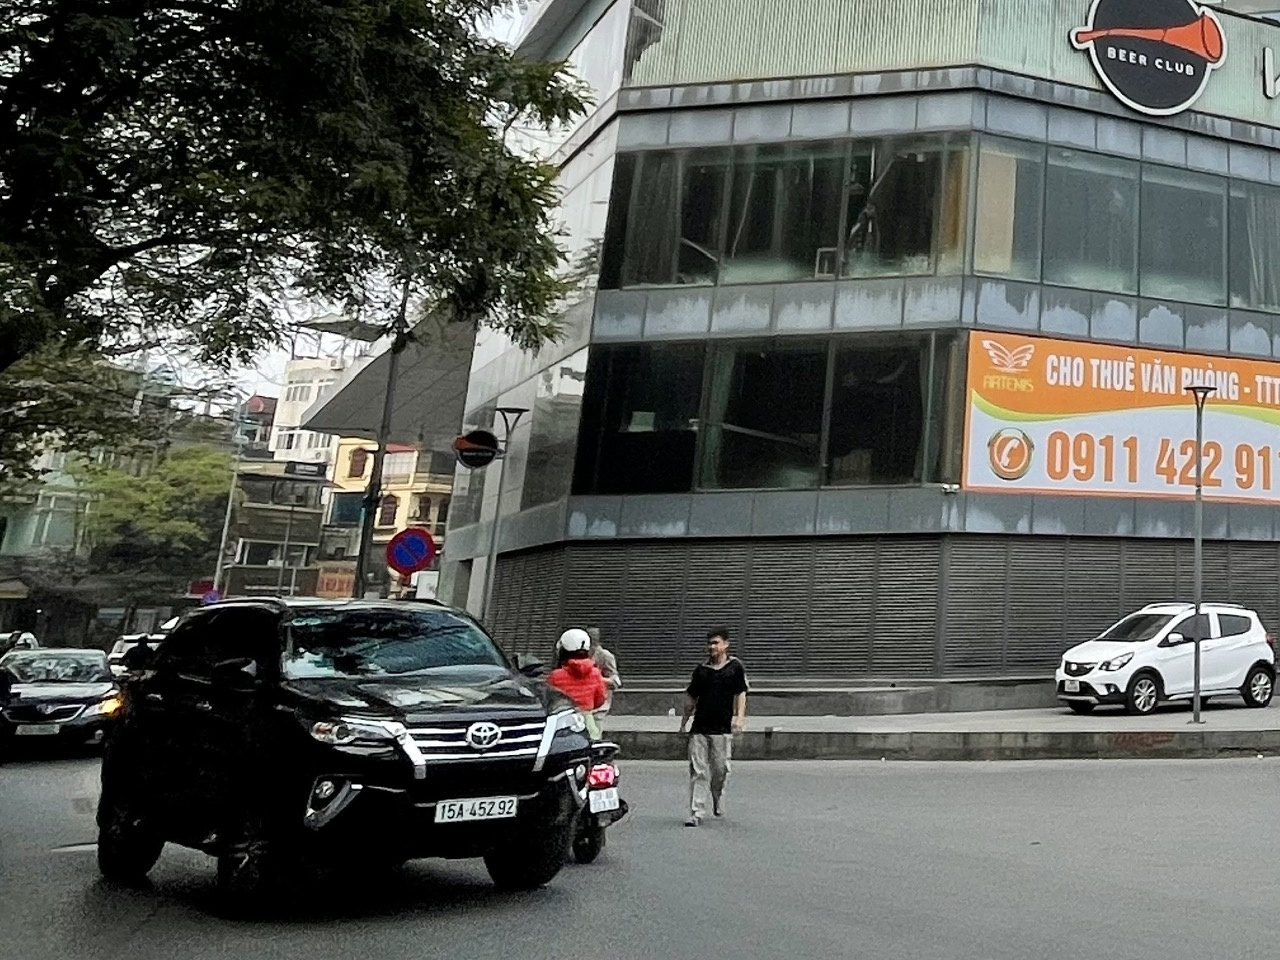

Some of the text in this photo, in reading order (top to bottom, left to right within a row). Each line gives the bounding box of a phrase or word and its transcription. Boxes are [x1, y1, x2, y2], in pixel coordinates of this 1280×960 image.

[1107, 46, 1195, 76] BEER CLUB
[1046, 354, 1085, 387] CHO
[1089, 355, 1136, 392] THUÊ
[1140, 357, 1177, 395] VĂN
[1181, 362, 1239, 401] PHÒNG
[1046, 430, 1139, 483] 0911
[1155, 437, 1223, 488] 422
